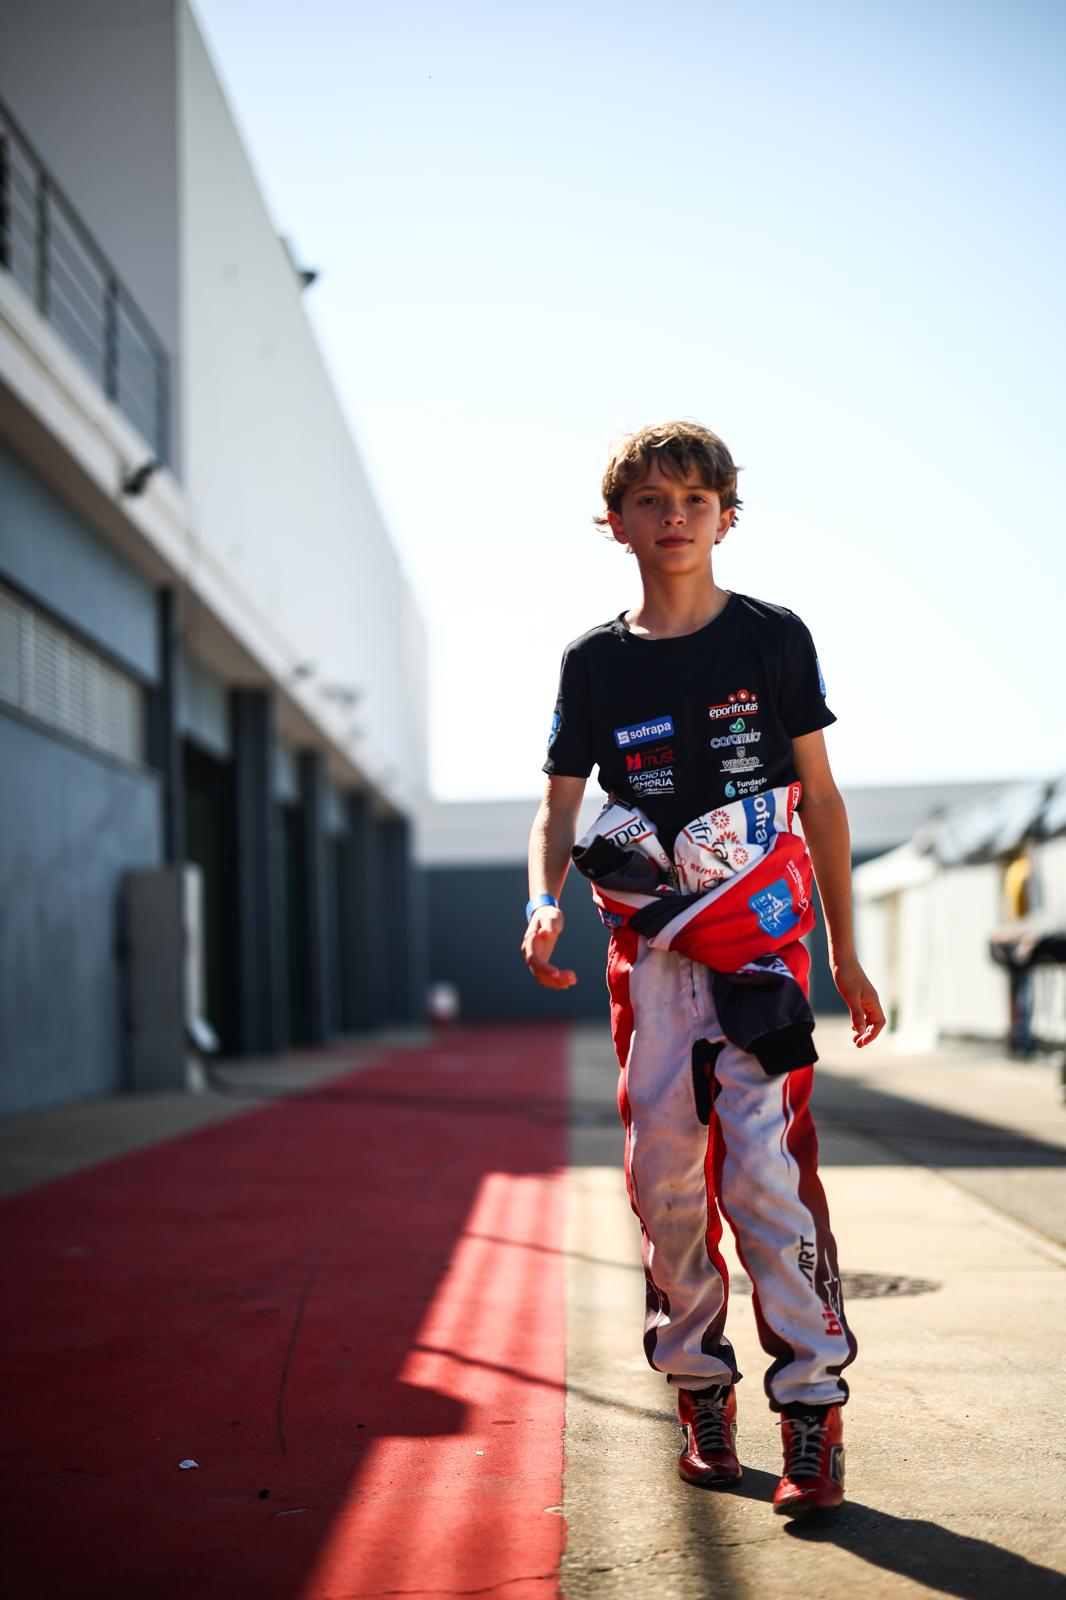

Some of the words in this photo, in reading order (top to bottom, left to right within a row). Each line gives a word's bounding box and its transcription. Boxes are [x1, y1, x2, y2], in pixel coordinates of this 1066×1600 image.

[630, 722, 671, 740] sofrapa
[629, 773, 658, 783] TACHO
[660, 769, 673, 777] DA
[690, 863, 724, 876] RE/MAX
[798, 1235, 815, 1283] ART
